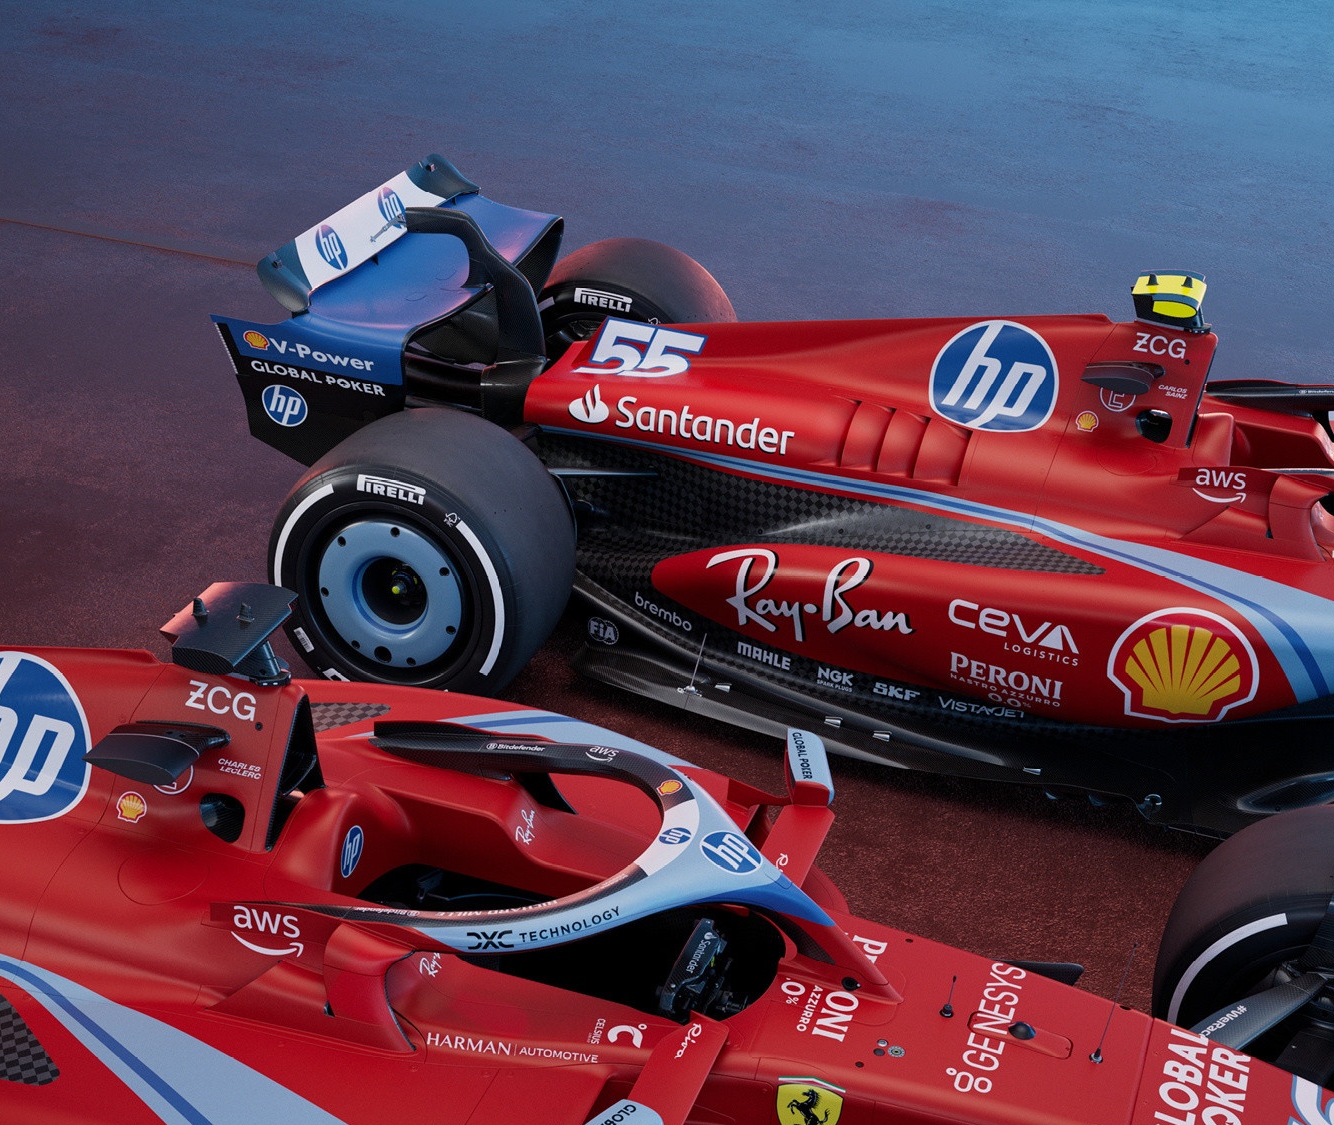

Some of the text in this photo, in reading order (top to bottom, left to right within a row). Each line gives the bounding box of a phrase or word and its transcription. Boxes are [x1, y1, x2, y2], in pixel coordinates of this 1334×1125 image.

[318, 227, 347, 270] hp
[574, 287, 633, 312] PIRELLI
[269, 338, 374, 371] V-Power
[572, 316, 710, 378] 55
[250, 360, 386, 397] GLOBAL POKER
[939, 322, 1048, 430] hp
[1158, 384, 1188, 394] CARLOS
[265, 385, 305, 427] hp
[1165, 391, 1188, 400] SAINZ
[615, 395, 795, 455] Santander
[357, 474, 427, 505] PIRELLI
[1196, 468, 1246, 490] aws
[634, 591, 692, 632] brembo
[737, 642, 791, 671] MAHLE
[1004, 642, 1079, 666] LOGISTICS
[817, 666, 854, 686] NGK
[873, 682, 920, 701] SKF
[950, 651, 1063, 700] PERONI
[950, 673, 1061, 708] NASTRO AZZURRO
[497, 743, 545, 752] Bitdefender
[590, 746, 620, 757] aws
[792, 732, 807, 757] GLOBAL
[218, 758, 261, 772] CHARLES
[220, 766, 262, 780] LECLERC
[342, 826, 364, 877] hp
[700, 831, 763, 874] hp
[233, 905, 301, 938] aws
[519, 906, 621, 943] TECHNOLOGY
[685, 938, 712, 974] Santander
[797, 985, 823, 1032] AZZURRO
[963, 962, 1026, 1071] GENESYS
[1199, 1005, 1247, 1038] #WeRac
[426, 1031, 599, 1064] HARMAN AUTOMOTIVE
[591, 1018, 606, 1045] CELSIUS
[674, 1023, 702, 1060] Riva
